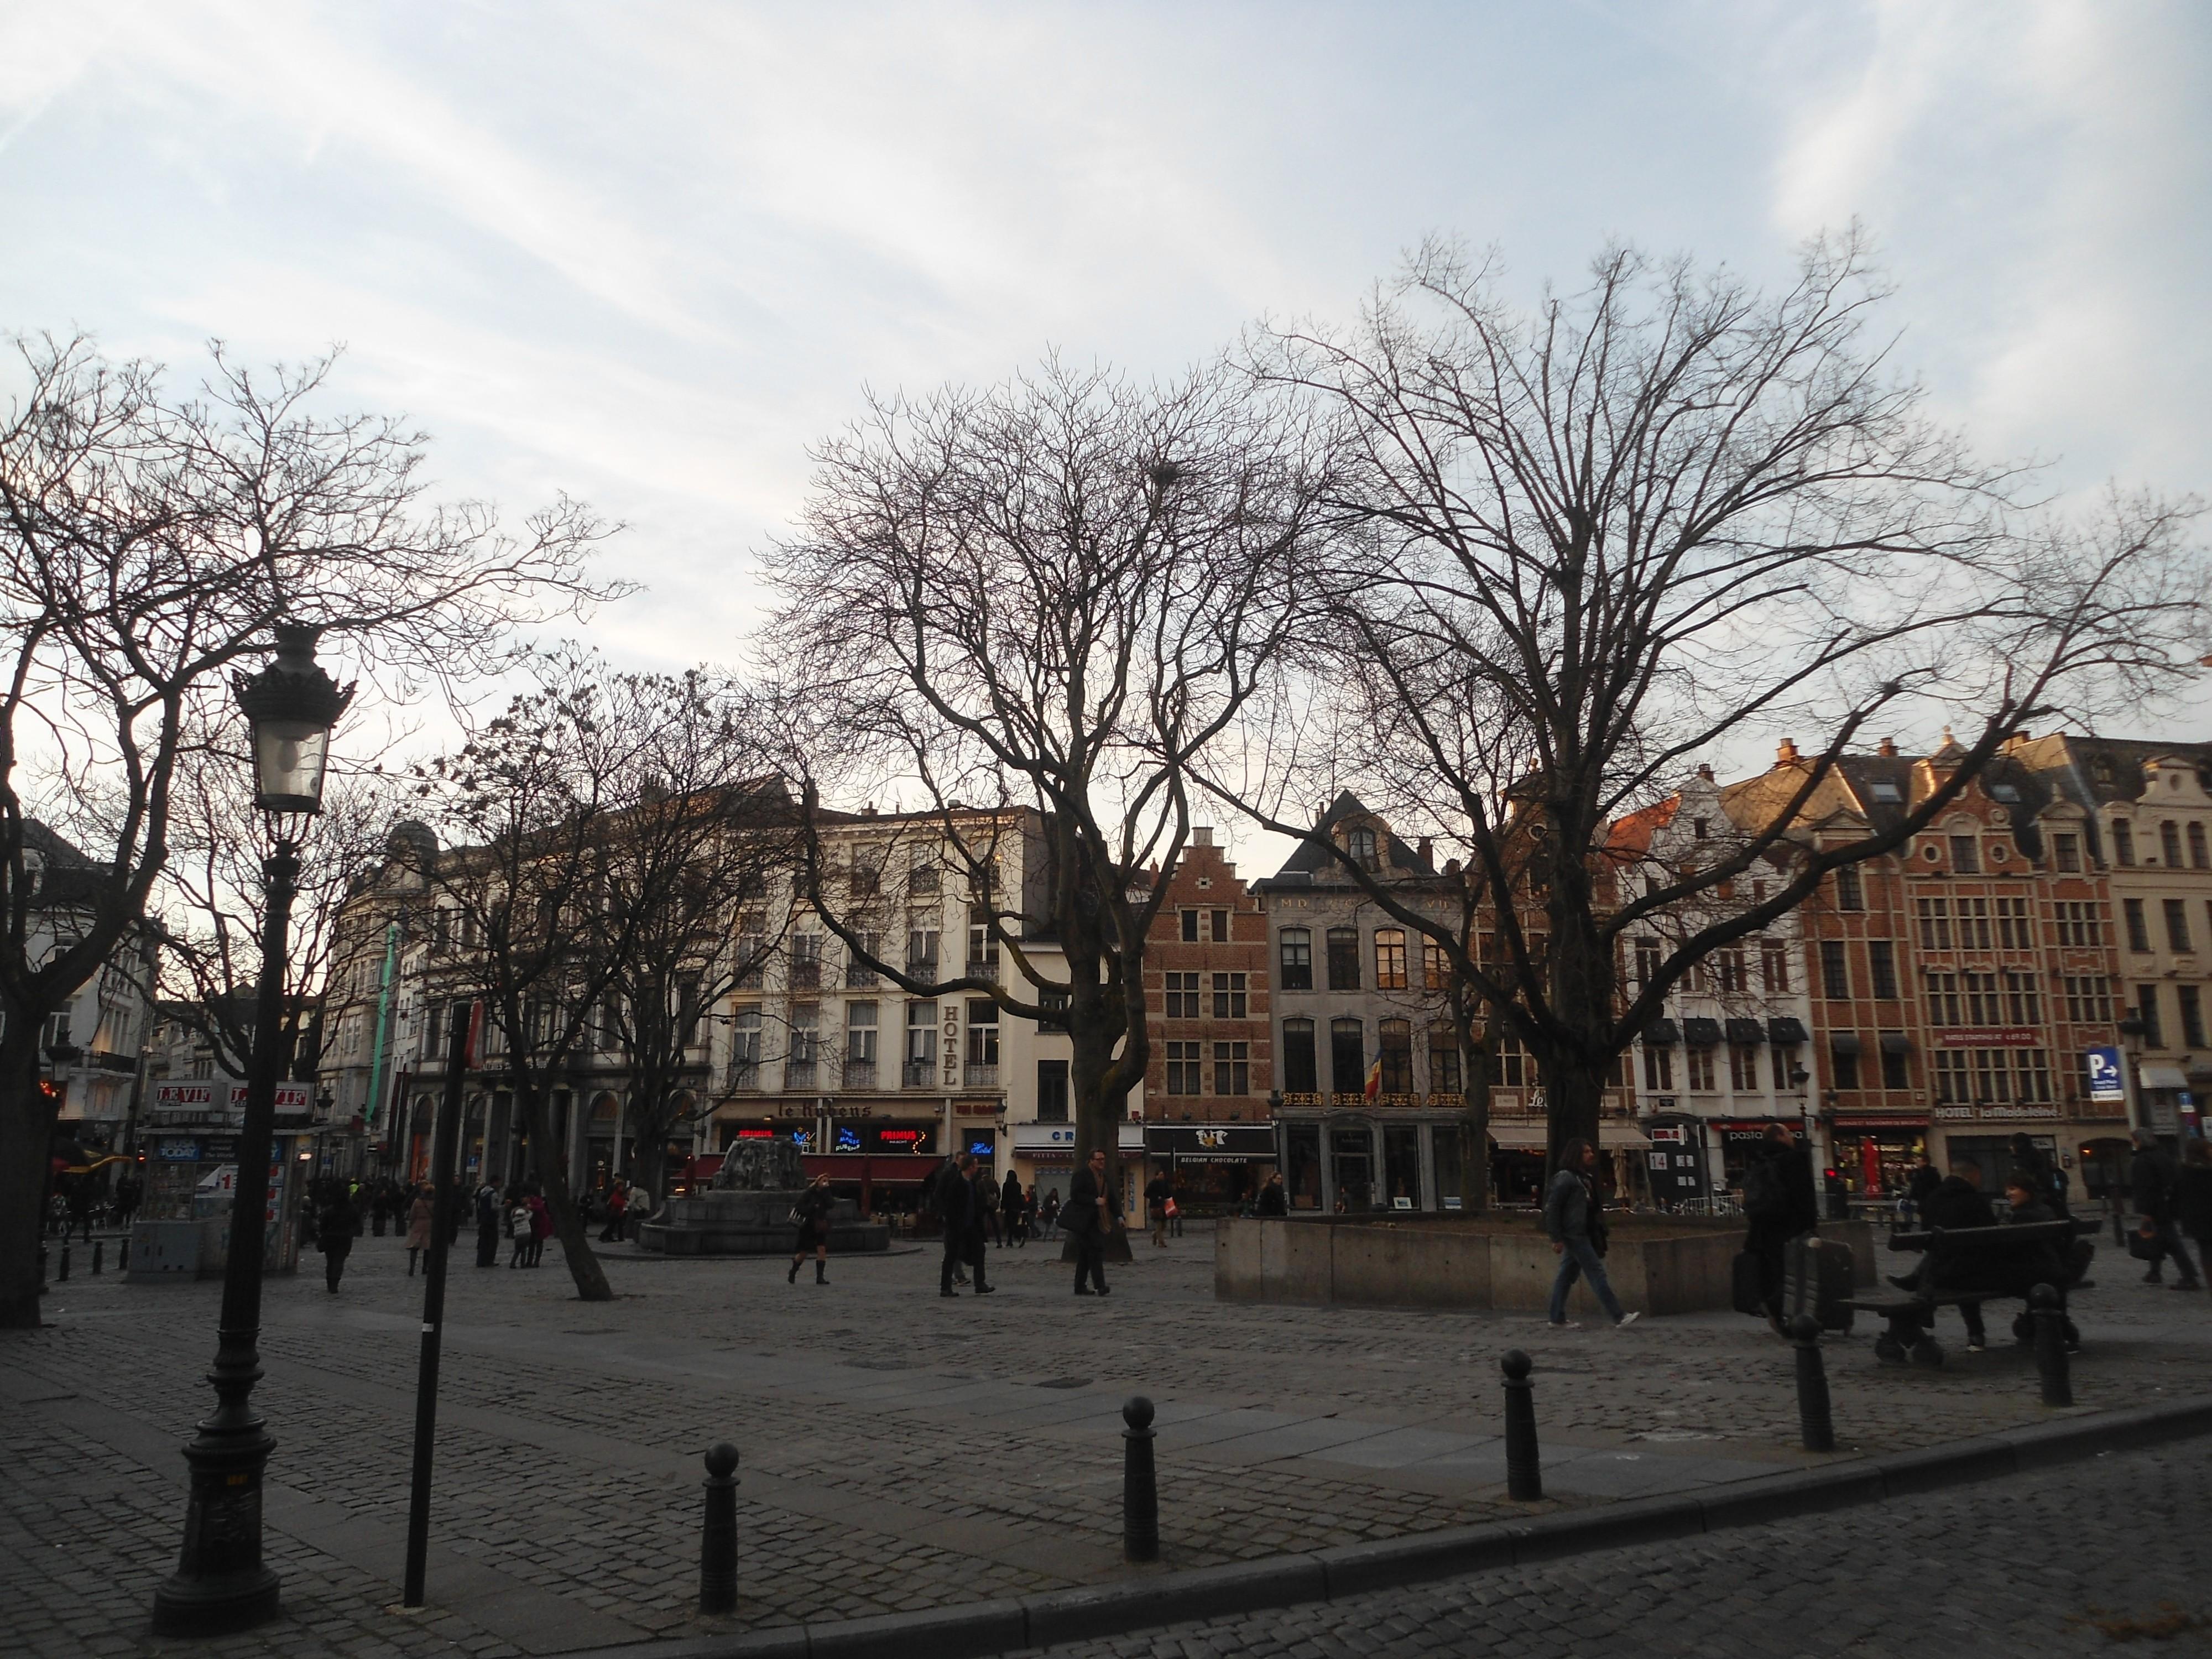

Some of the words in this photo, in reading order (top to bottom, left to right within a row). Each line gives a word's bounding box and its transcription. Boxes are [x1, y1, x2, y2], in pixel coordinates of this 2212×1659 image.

[943, 1006, 958, 1085] HOTEL
[2089, 1054, 2104, 1079] P
[158, 1087, 179, 1102] LE
[180, 1087, 210, 1102] VIF
[802, 1102, 872, 1118] Rubens
[1936, 1107, 1973, 1118] HOTEL
[880, 1130, 917, 1140] PRIMUS
[1730, 1131, 1763, 1141] pasta
[160, 1147, 196, 1157] TODAY
[836, 1143, 862, 1152] RUBENS
[971, 1141, 994, 1155] Hotel
